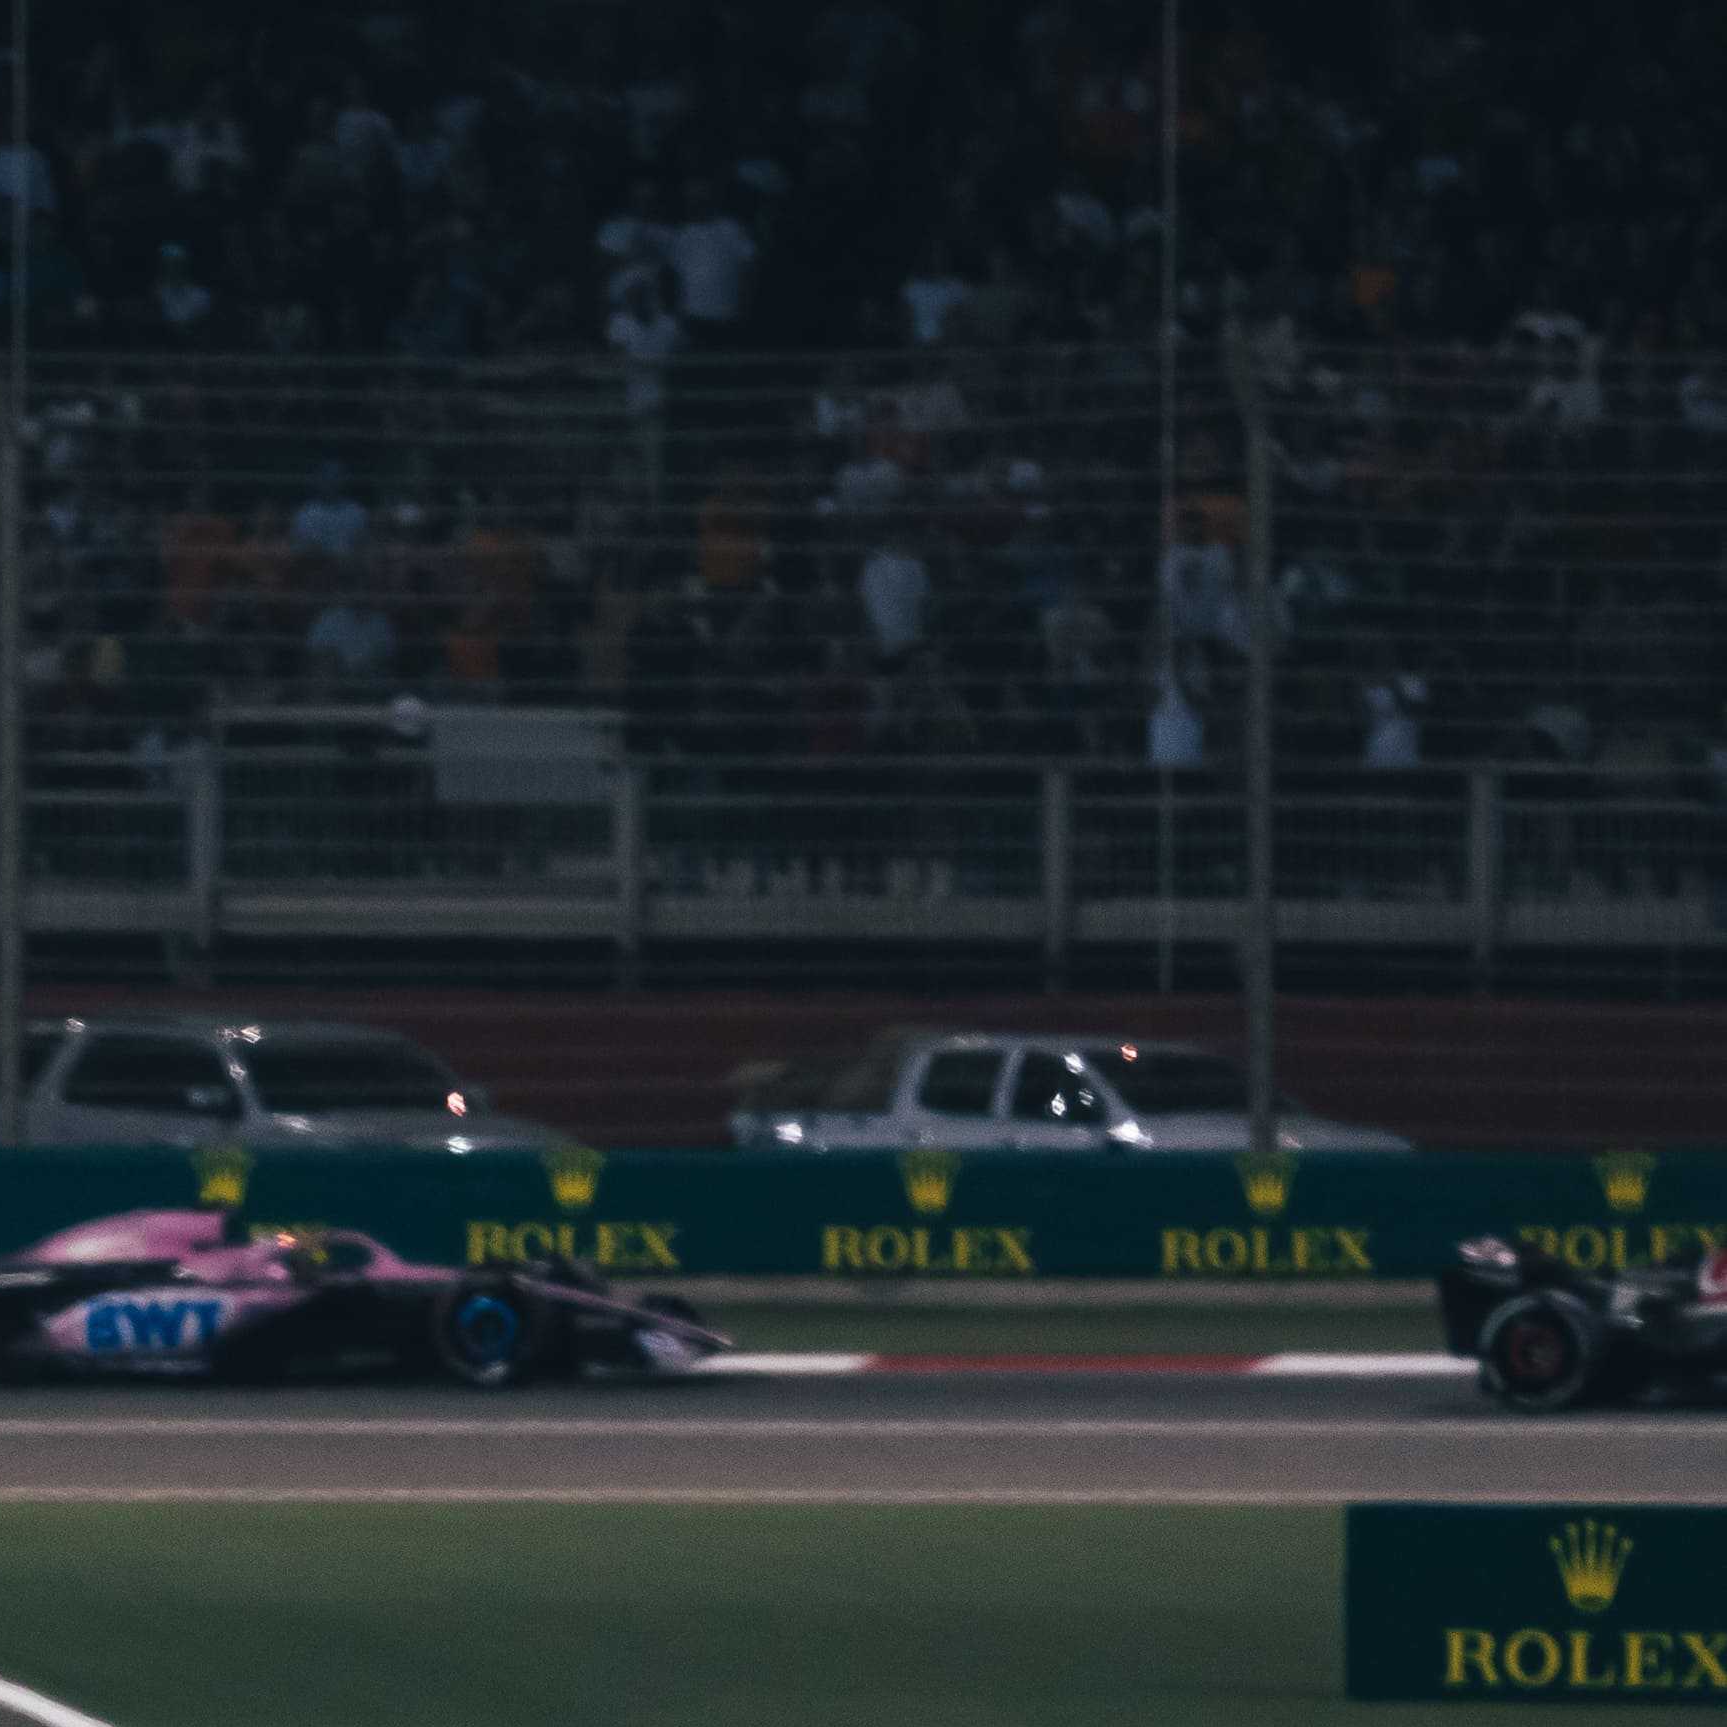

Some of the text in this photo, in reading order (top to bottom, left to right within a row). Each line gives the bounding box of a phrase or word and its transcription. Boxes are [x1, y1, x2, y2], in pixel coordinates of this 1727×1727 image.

[467, 1221, 681, 1266] ROLEX
[822, 1225, 1033, 1270] ROLEX
[1161, 1227, 1370, 1270] ROLEX
[87, 1300, 220, 1353] BWT
[1443, 1627, 1727, 1688] ROLEX
